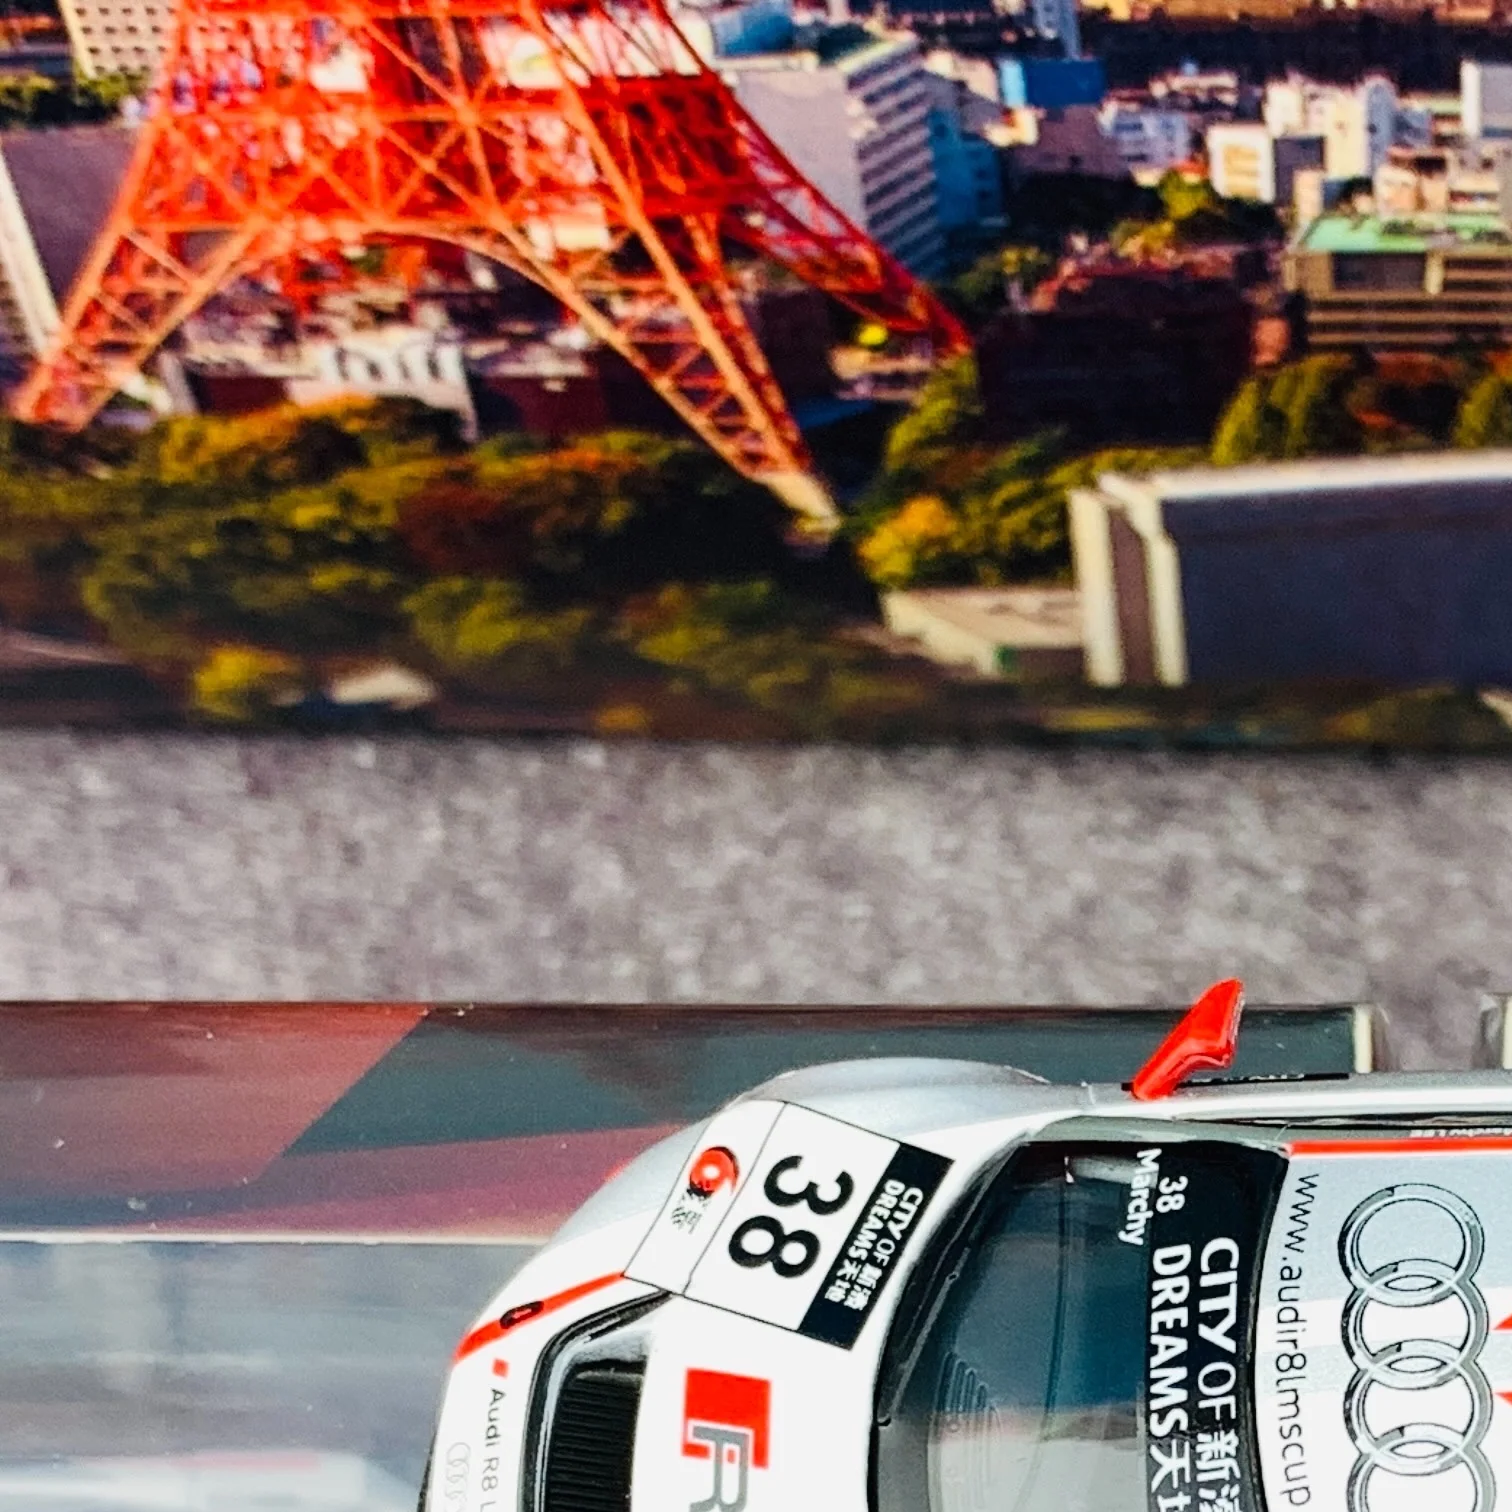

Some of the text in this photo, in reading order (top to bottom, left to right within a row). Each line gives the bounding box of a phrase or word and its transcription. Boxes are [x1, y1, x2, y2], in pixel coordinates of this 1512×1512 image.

[728, 1154, 854, 1279] 38
[847, 1179, 906, 1261] DREAMS
[887, 1187, 924, 1241] CITY
[1118, 1148, 1162, 1246] Marchy
[1155, 1175, 1189, 1214] 38
[873, 1238, 896, 1267] OF
[1198, 1237, 1240, 1354] CITY
[1149, 1243, 1192, 1438] DREAMS
[484, 1387, 507, 1448] Audi
[1197, 1361, 1237, 1421] OF
[481, 1457, 500, 1492] R8
